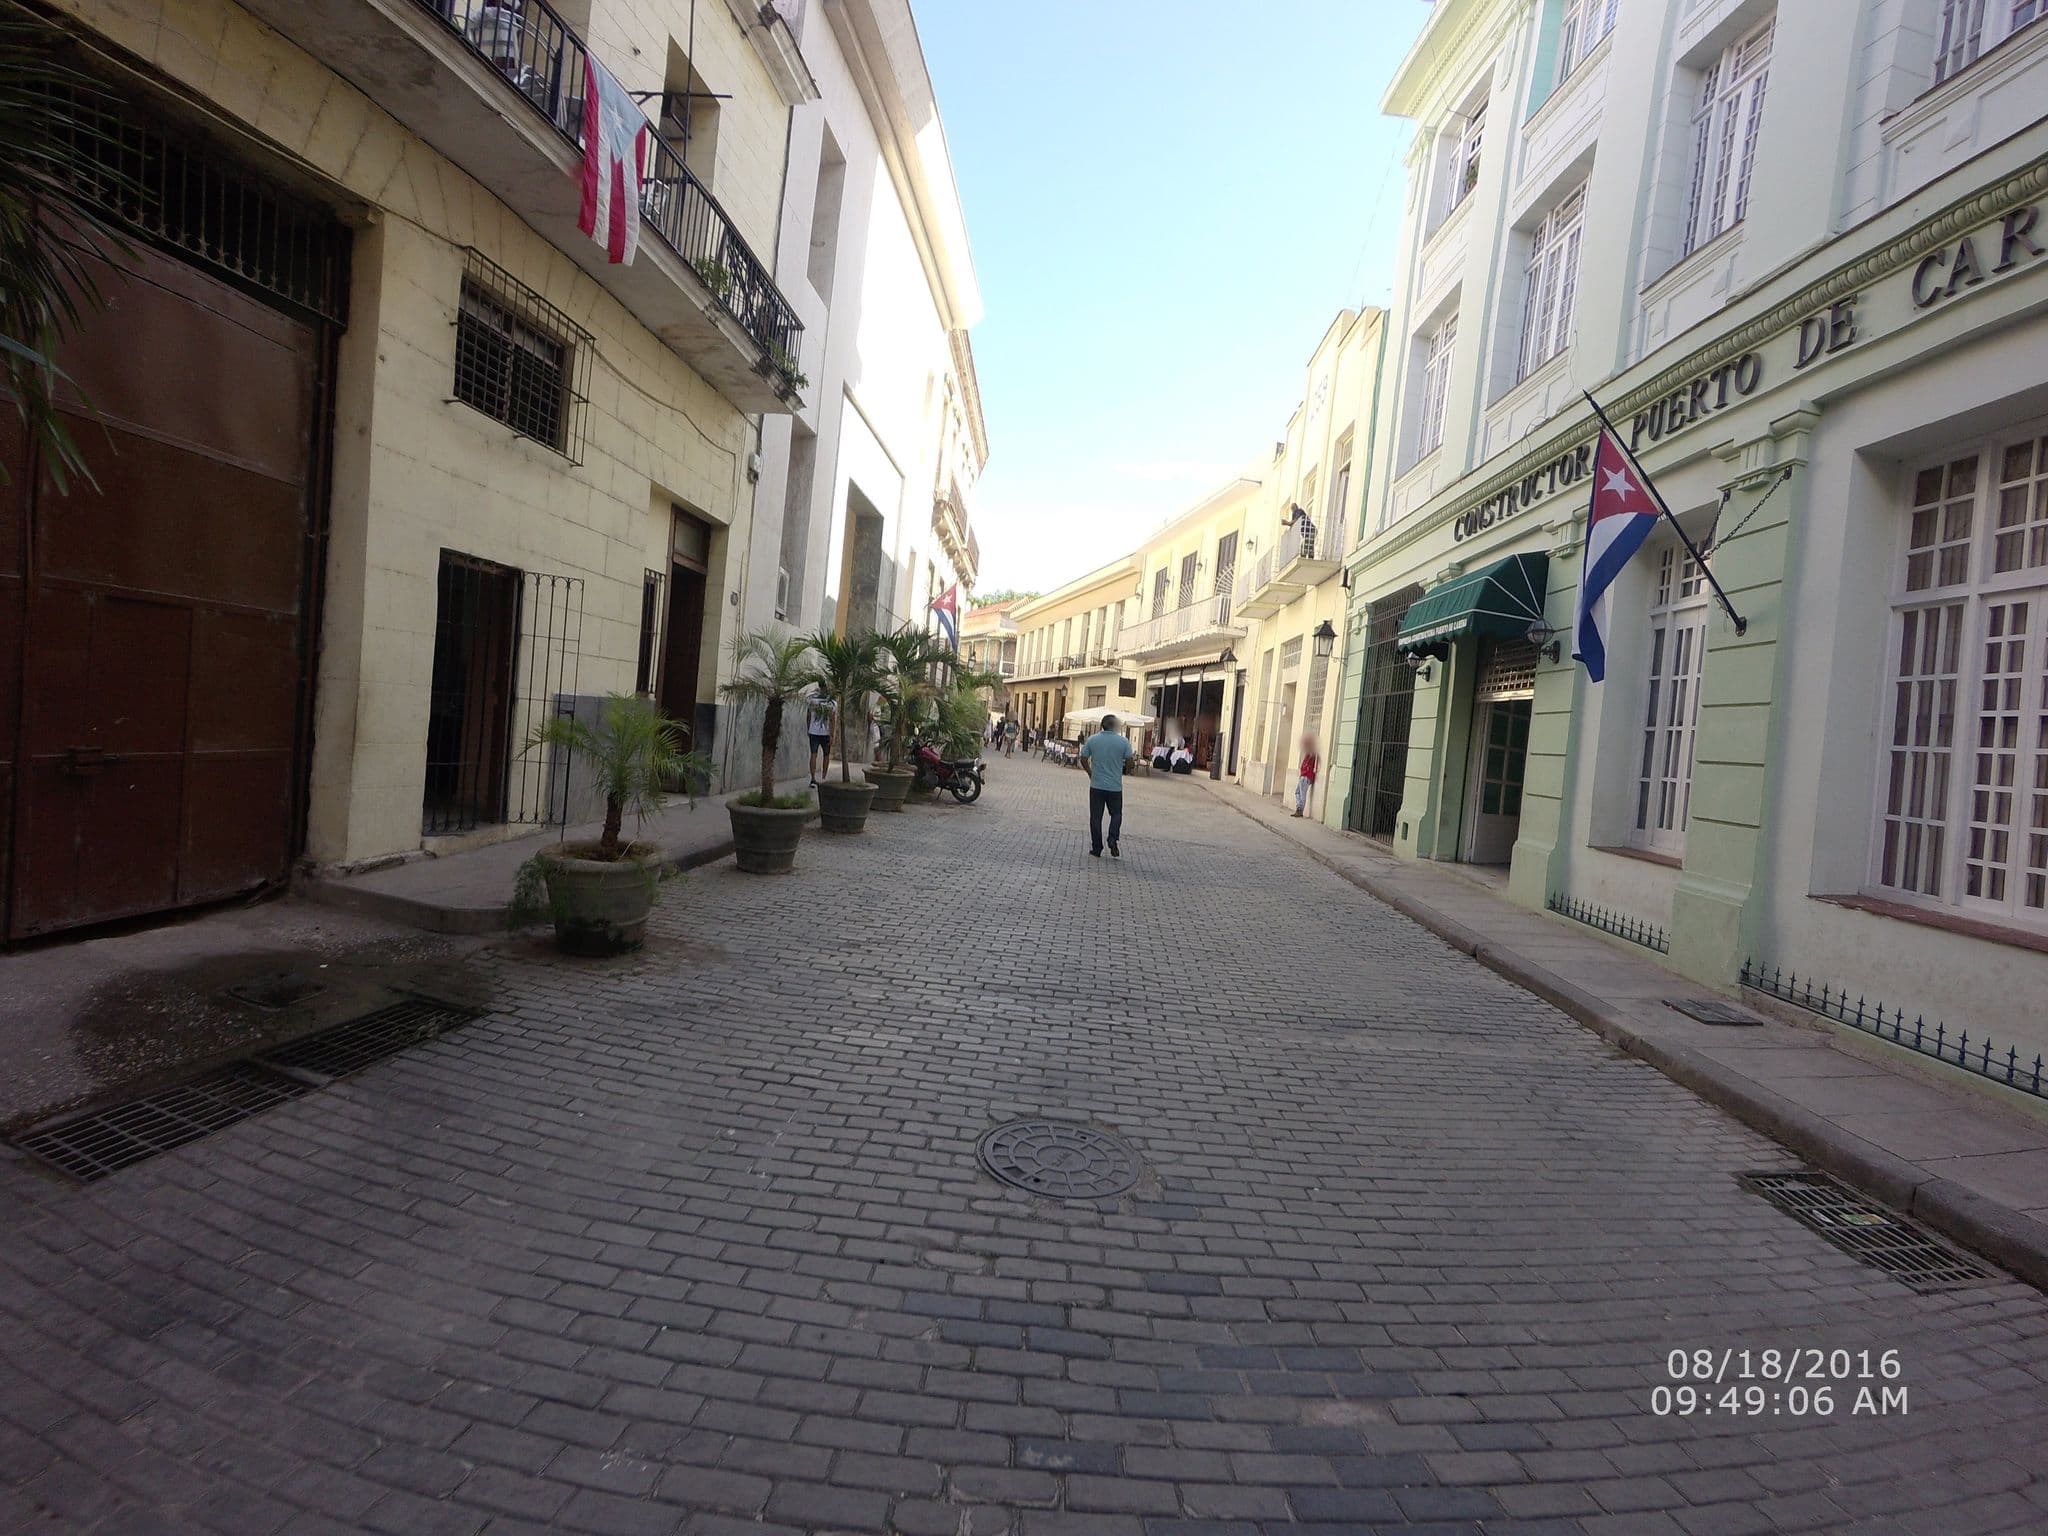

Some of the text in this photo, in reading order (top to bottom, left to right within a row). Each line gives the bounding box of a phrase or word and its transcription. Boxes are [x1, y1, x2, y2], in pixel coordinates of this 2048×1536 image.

[1454, 206, 2046, 542] CONSTRUCTOR PUERTO DE CAR
